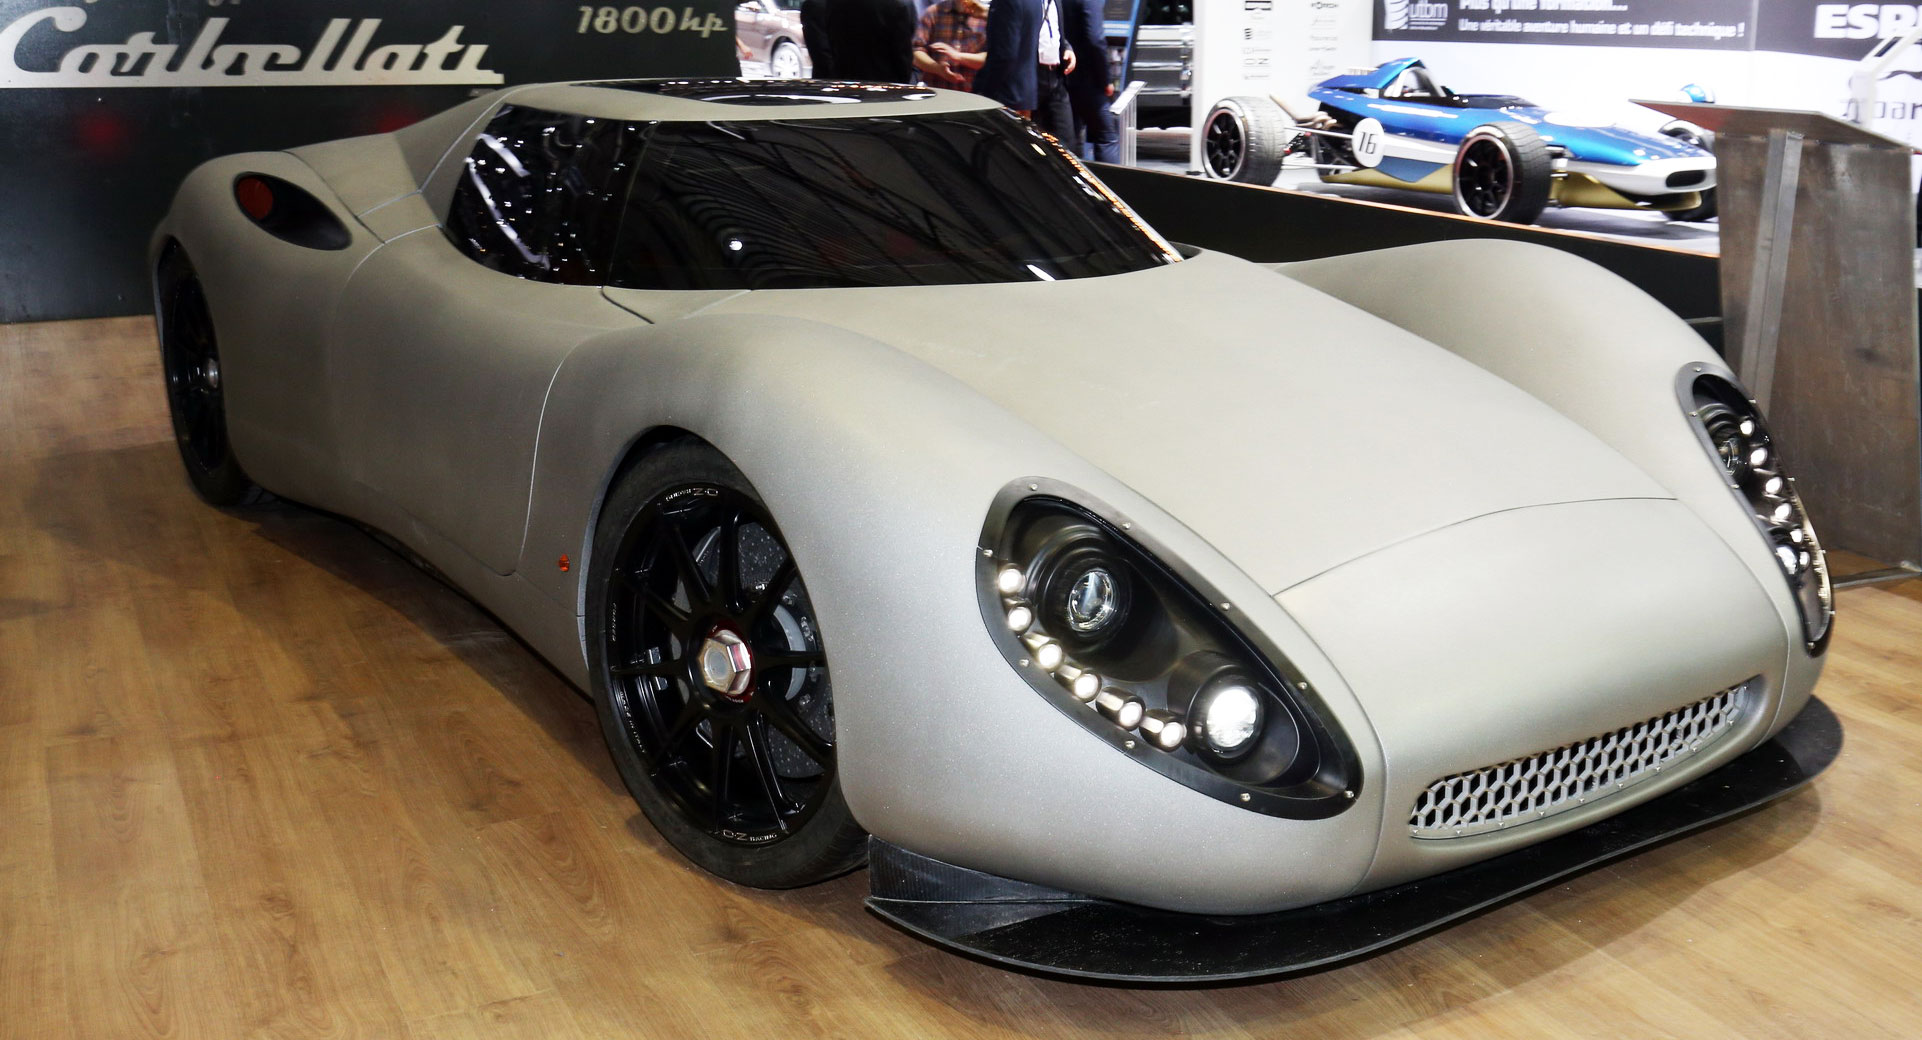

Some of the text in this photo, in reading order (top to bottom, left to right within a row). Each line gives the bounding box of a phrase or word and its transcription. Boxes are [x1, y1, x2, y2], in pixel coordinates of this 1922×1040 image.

[576, 6, 728, 38] 1800 hp
[1458, 19, 1478, 31] Une
[1479, 19, 1522, 33] véritable
[1523, 21, 1569, 34] aventure
[1570, 20, 1616, 35] humaine
[1617, 22, 1632, 35] et
[1632, 24, 1649, 36] un
[1814, 4, 1922, 39] ESP
[1358, 131, 1378, 155] 16
